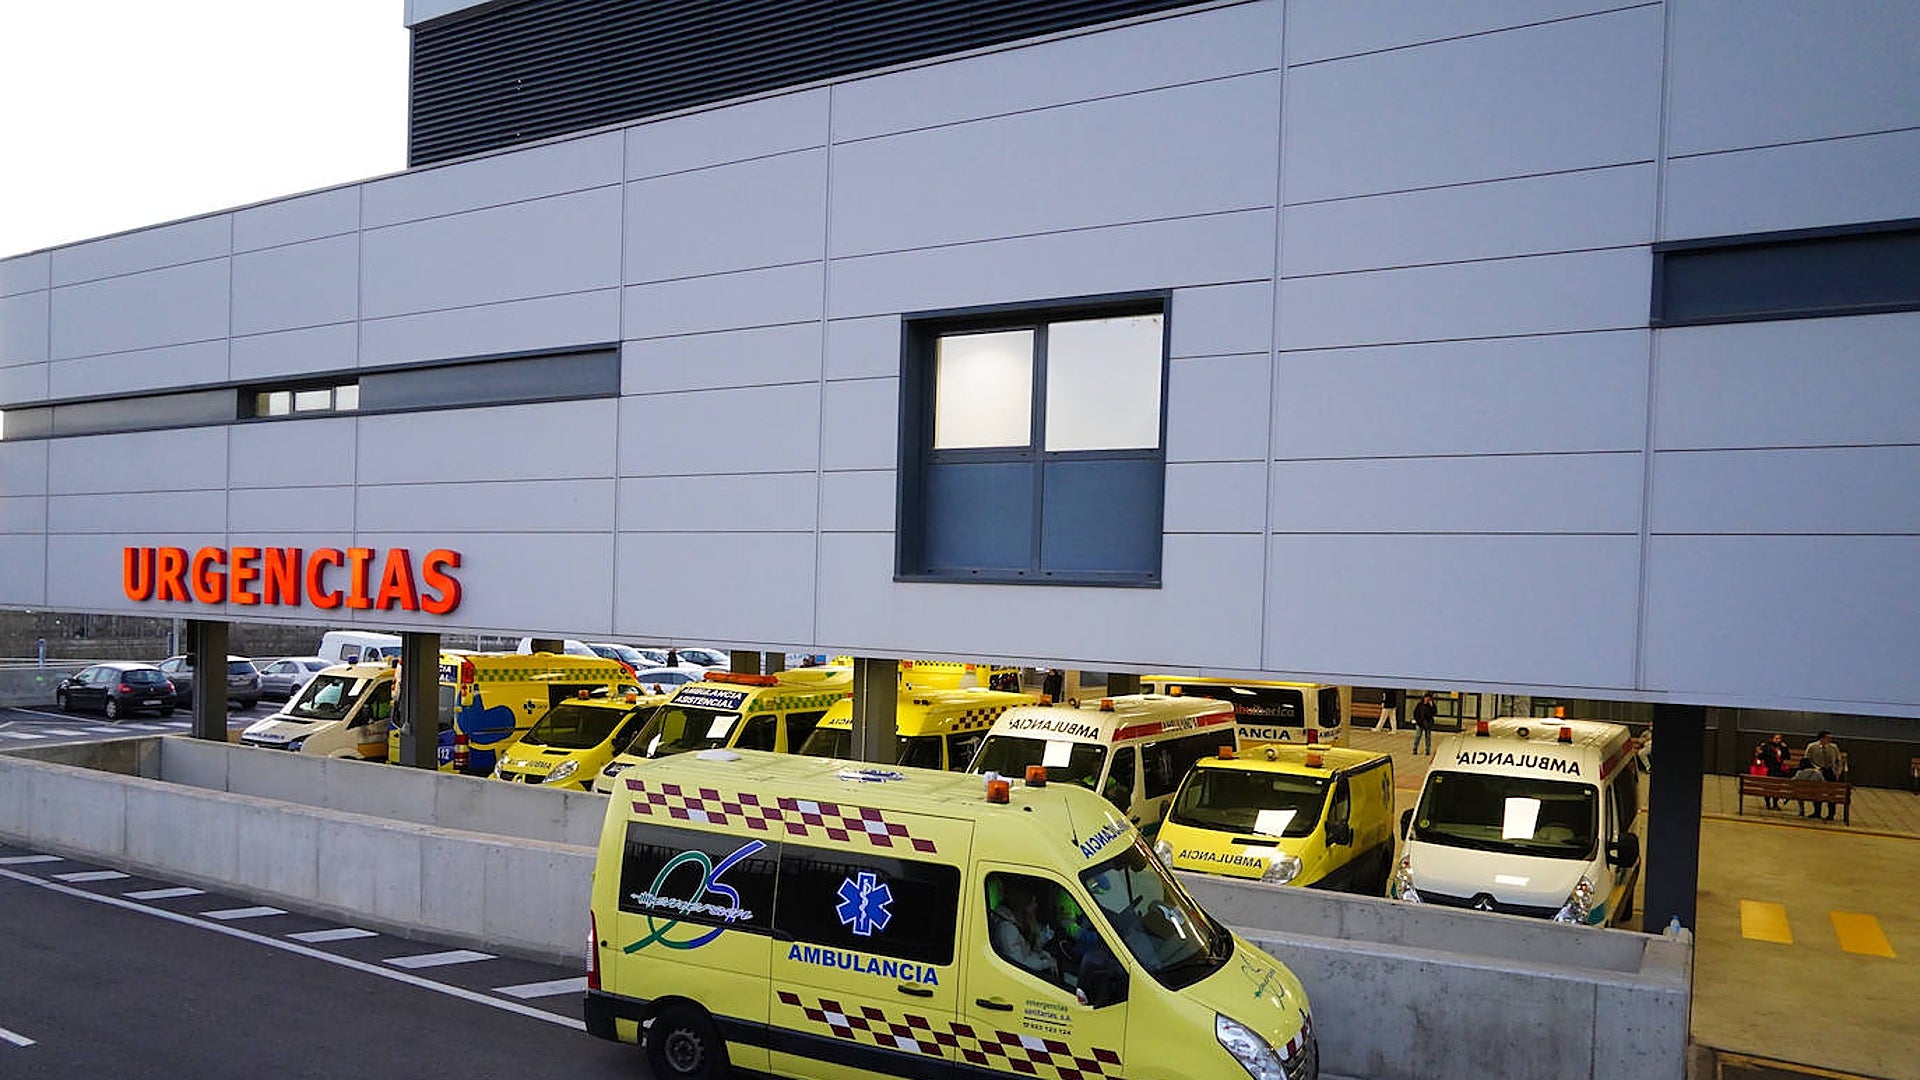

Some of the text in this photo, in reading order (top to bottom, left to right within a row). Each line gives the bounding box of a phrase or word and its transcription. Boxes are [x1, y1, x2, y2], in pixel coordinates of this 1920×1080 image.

[122, 546, 463, 616] URGENCIAS
[681, 687, 742, 700] AMBULANCIA
[1238, 727, 1291, 740] ANCIA
[788, 944, 939, 986] AMBULANCIA
